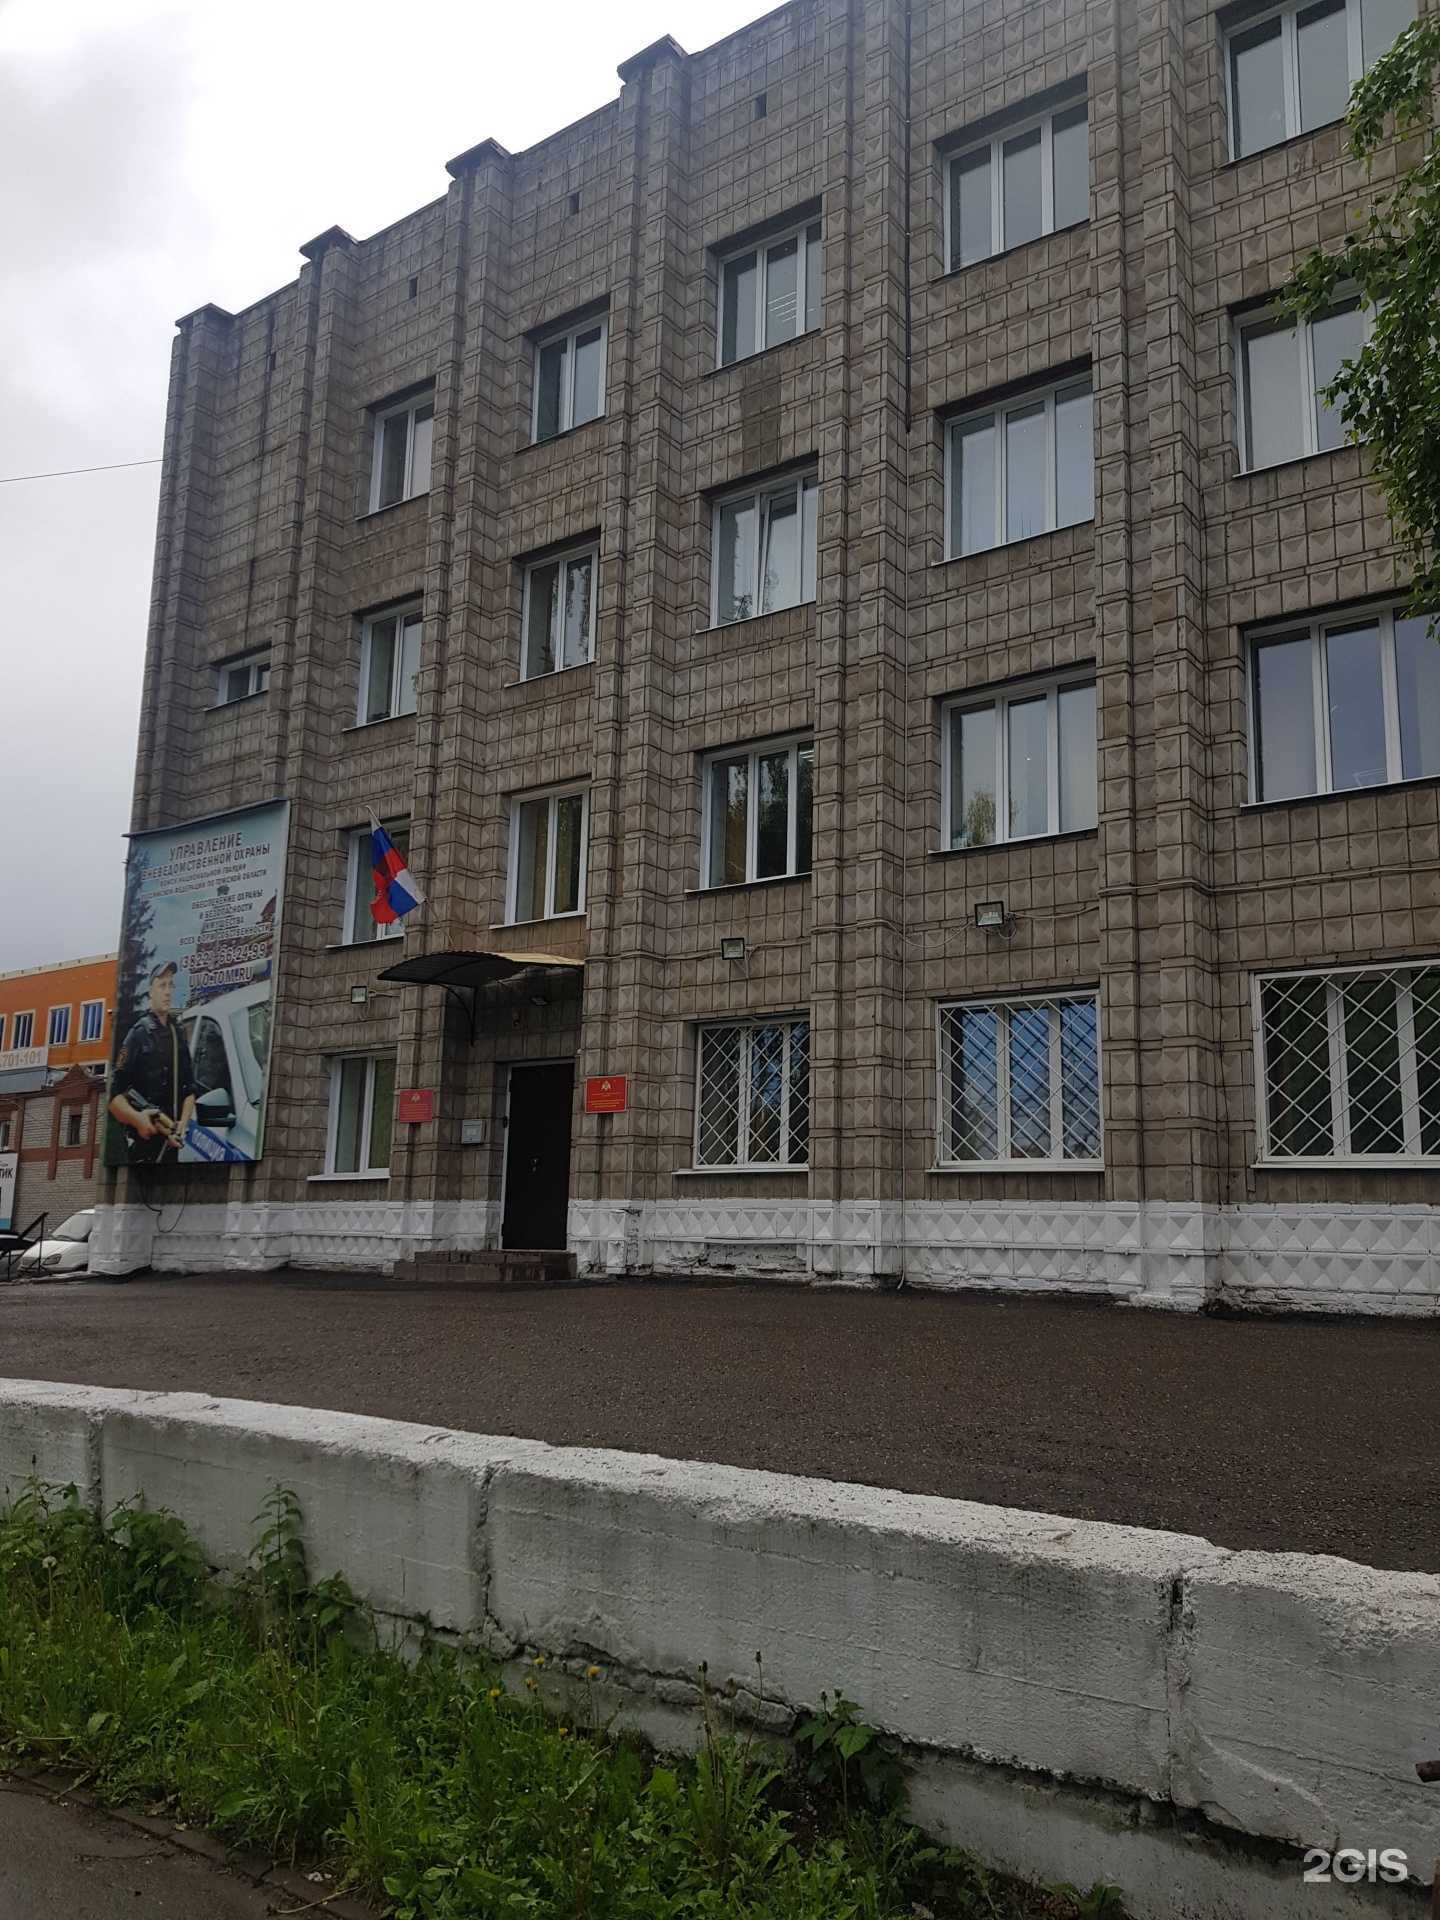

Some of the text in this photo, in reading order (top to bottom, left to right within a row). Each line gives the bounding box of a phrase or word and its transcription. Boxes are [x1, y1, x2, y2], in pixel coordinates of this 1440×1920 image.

[169, 832, 242, 861] УПРАВЛЕНИЕ
[142, 843, 270, 880] ВНЕВЕДОМСТВЕННОЙ ОХРАНЫ
[237, 889, 263, 901] ОХРАНЫ
